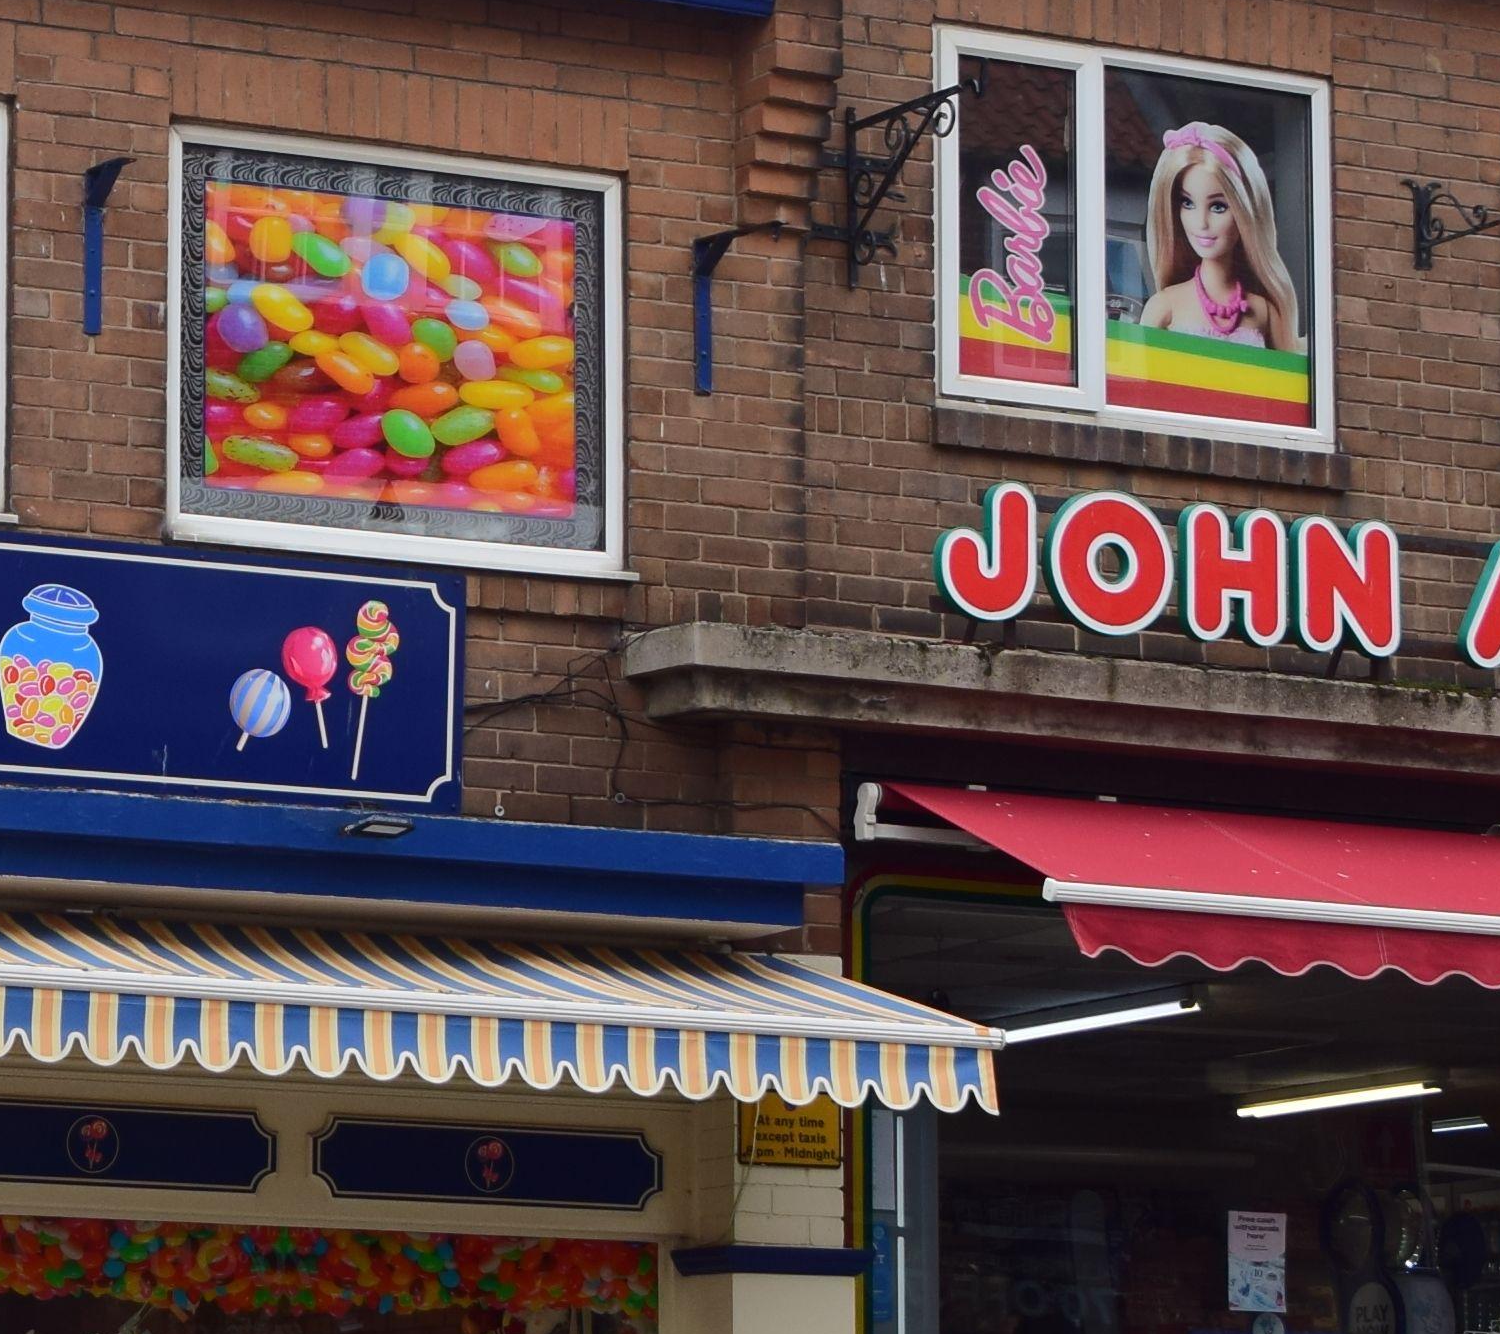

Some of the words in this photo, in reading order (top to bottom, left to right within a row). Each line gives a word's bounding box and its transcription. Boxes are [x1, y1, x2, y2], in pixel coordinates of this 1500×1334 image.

[969, 143, 1054, 345] Barbie
[936, 482, 1401, 658] JOHN
[757, 1115, 770, 1127] At
[774, 1116, 795, 1129] any
[799, 1116, 825, 1128] time
[755, 1131, 795, 1145] except
[799, 1132, 828, 1144] taxis
[784, 1147, 836, 1162] Midnight
